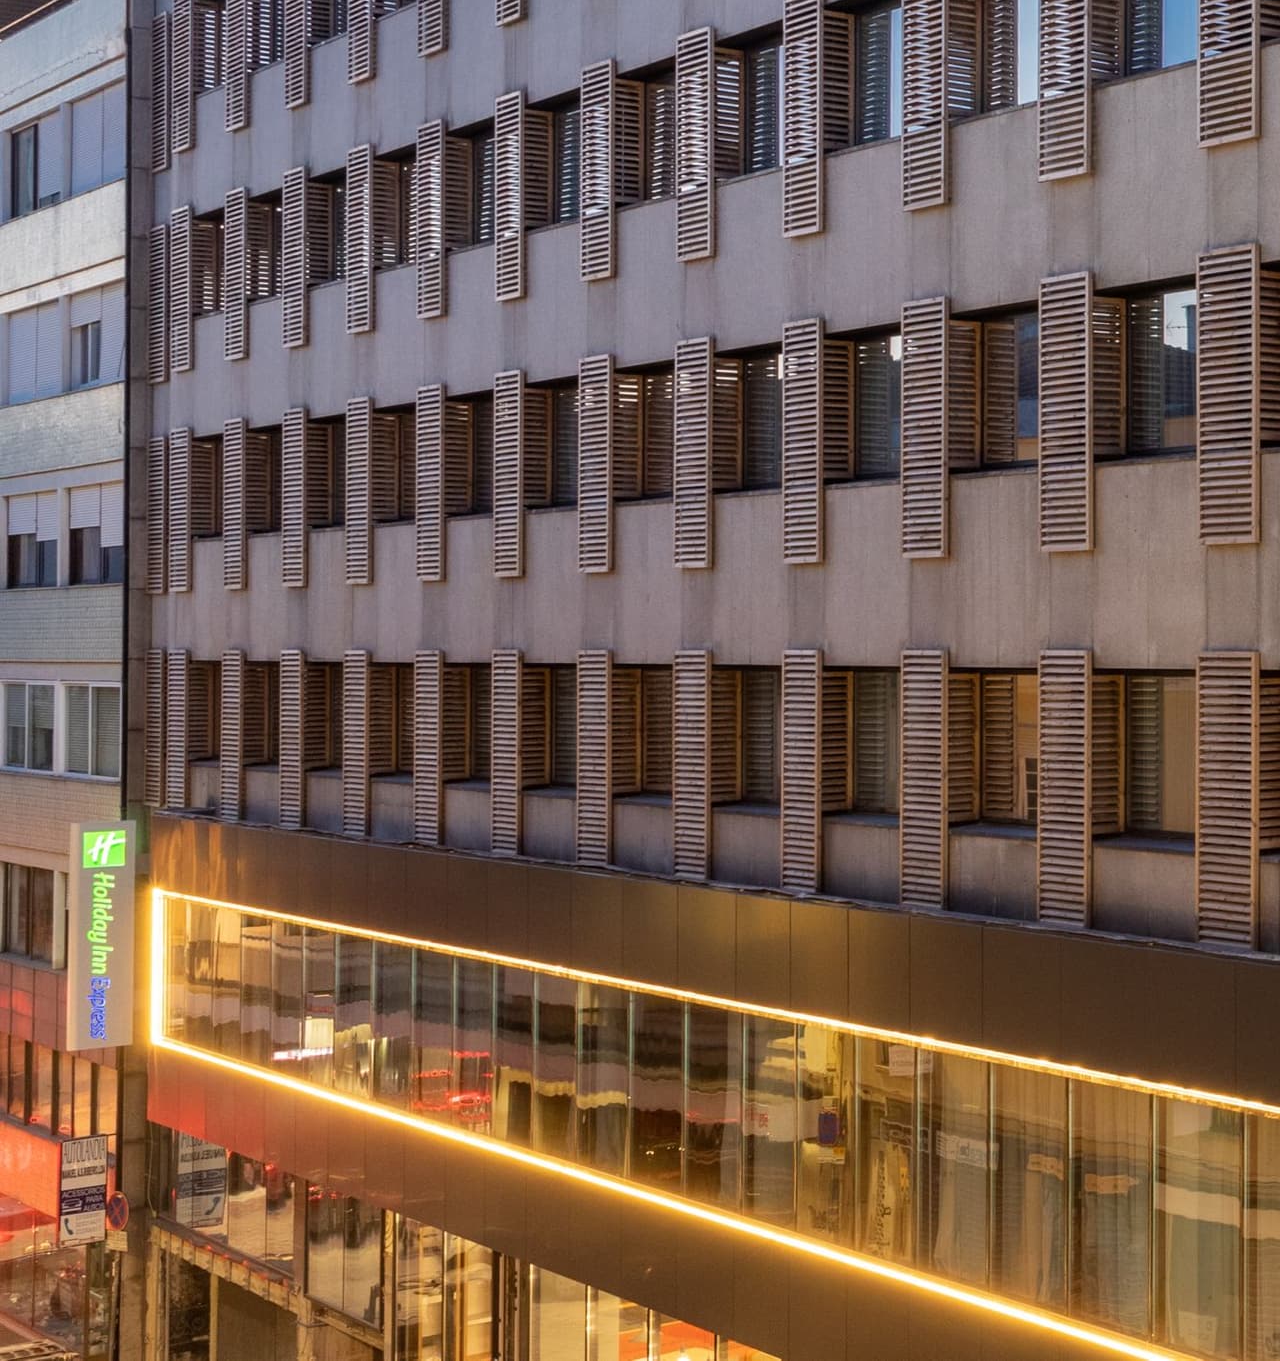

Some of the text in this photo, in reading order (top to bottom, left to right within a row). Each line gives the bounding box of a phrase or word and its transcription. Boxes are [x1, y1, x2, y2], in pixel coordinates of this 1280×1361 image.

[87, 871, 116, 1040] Holiday Inn Express
